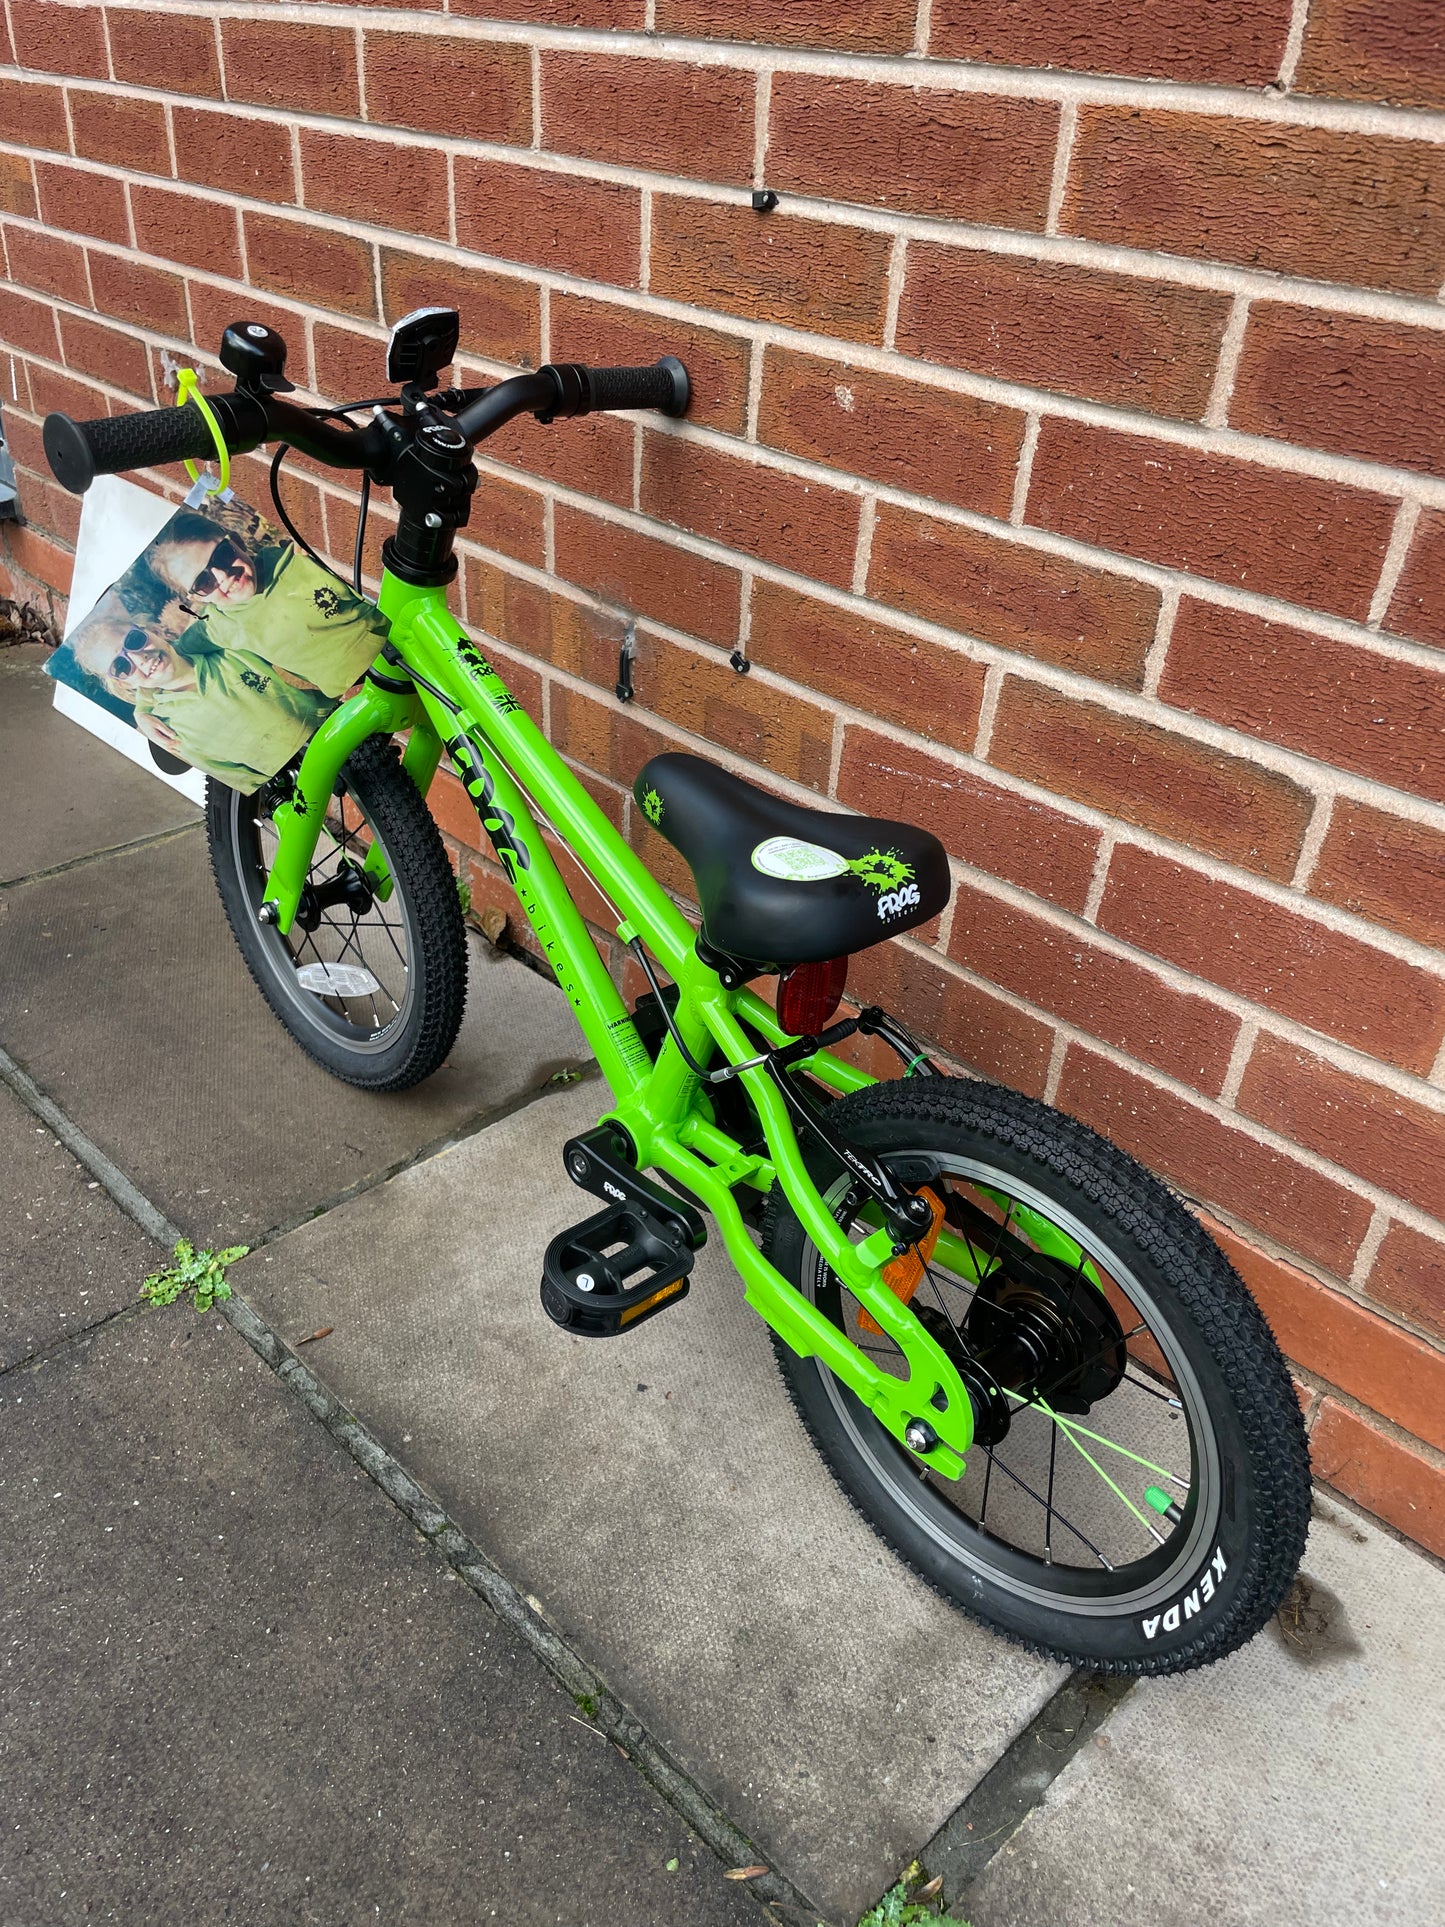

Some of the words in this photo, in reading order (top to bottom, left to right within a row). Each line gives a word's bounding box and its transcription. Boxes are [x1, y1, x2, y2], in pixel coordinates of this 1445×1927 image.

[469, 666, 494, 681] FRO
[877, 884, 921, 919] FROG
[528, 903, 574, 992] bikes
[844, 1149, 882, 1186] TEKTRO
[603, 1181, 627, 1201] FROG
[1142, 1546, 1227, 1639] KENDA
